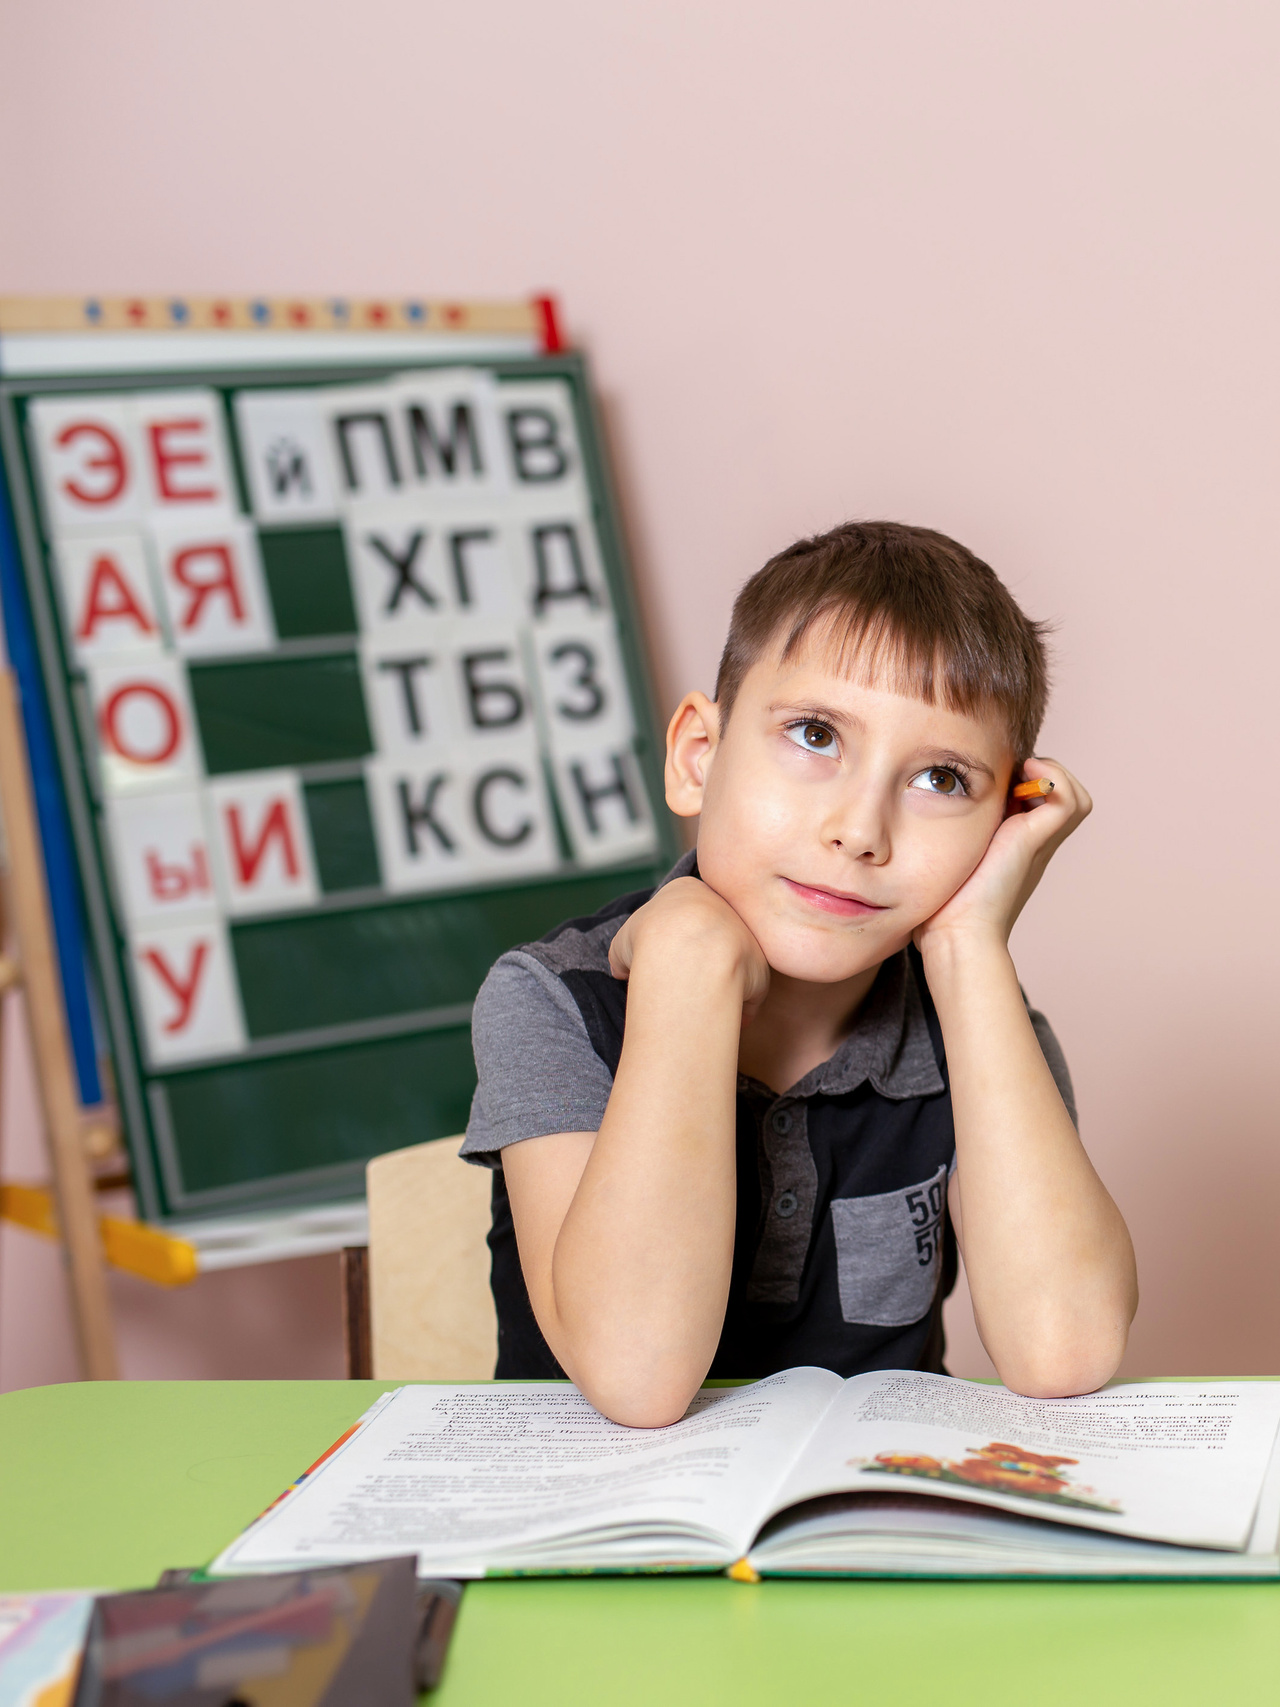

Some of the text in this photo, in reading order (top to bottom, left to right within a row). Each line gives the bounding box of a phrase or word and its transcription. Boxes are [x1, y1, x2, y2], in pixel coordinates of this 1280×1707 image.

[57, 421, 130, 507] Э
[147, 419, 217, 504] Е
[332, 409, 403, 493] П
[404, 400, 485, 479] М
[505, 407, 571, 485] В
[77, 521, 600, 642] А Я Х Г Д
[98, 681, 184, 767] О
[376, 656, 435, 739] Т
[460, 649, 525, 731] Б
[226, 799, 300, 887] И
[396, 774, 456, 858] К
[471, 768, 534, 849] С
[570, 756, 641, 837] Н
[143, 941, 209, 1034] У
[905, 1181, 942, 1227] 50
